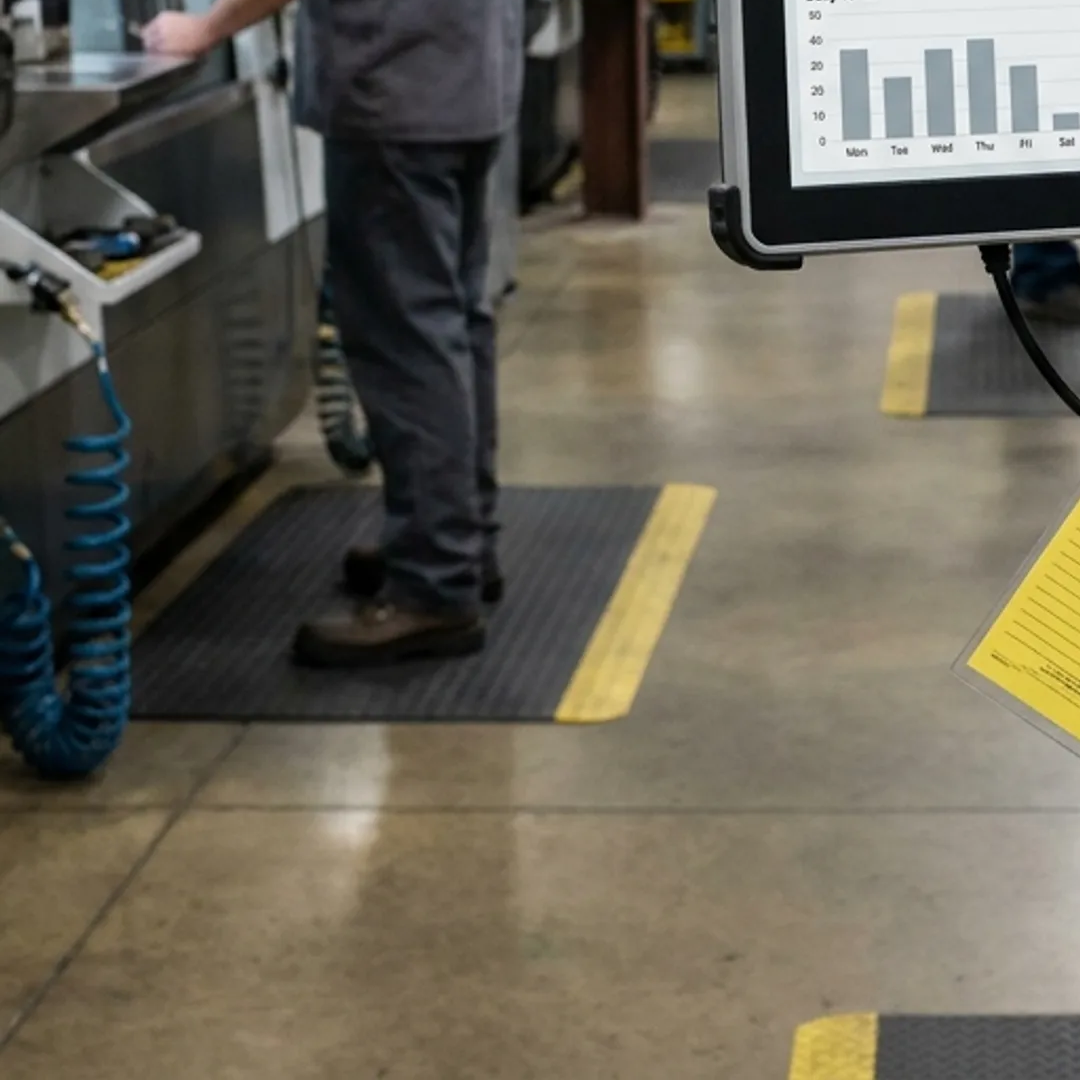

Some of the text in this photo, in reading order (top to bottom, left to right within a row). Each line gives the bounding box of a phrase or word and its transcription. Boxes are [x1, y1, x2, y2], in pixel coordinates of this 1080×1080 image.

[809, 10, 821, 20] 50
[809, 36, 823, 45] 40
[811, 85, 824, 96] 20
[813, 111, 825, 121] 10
[819, 136, 826, 146] 0
[976, 141, 994, 151] Thu
